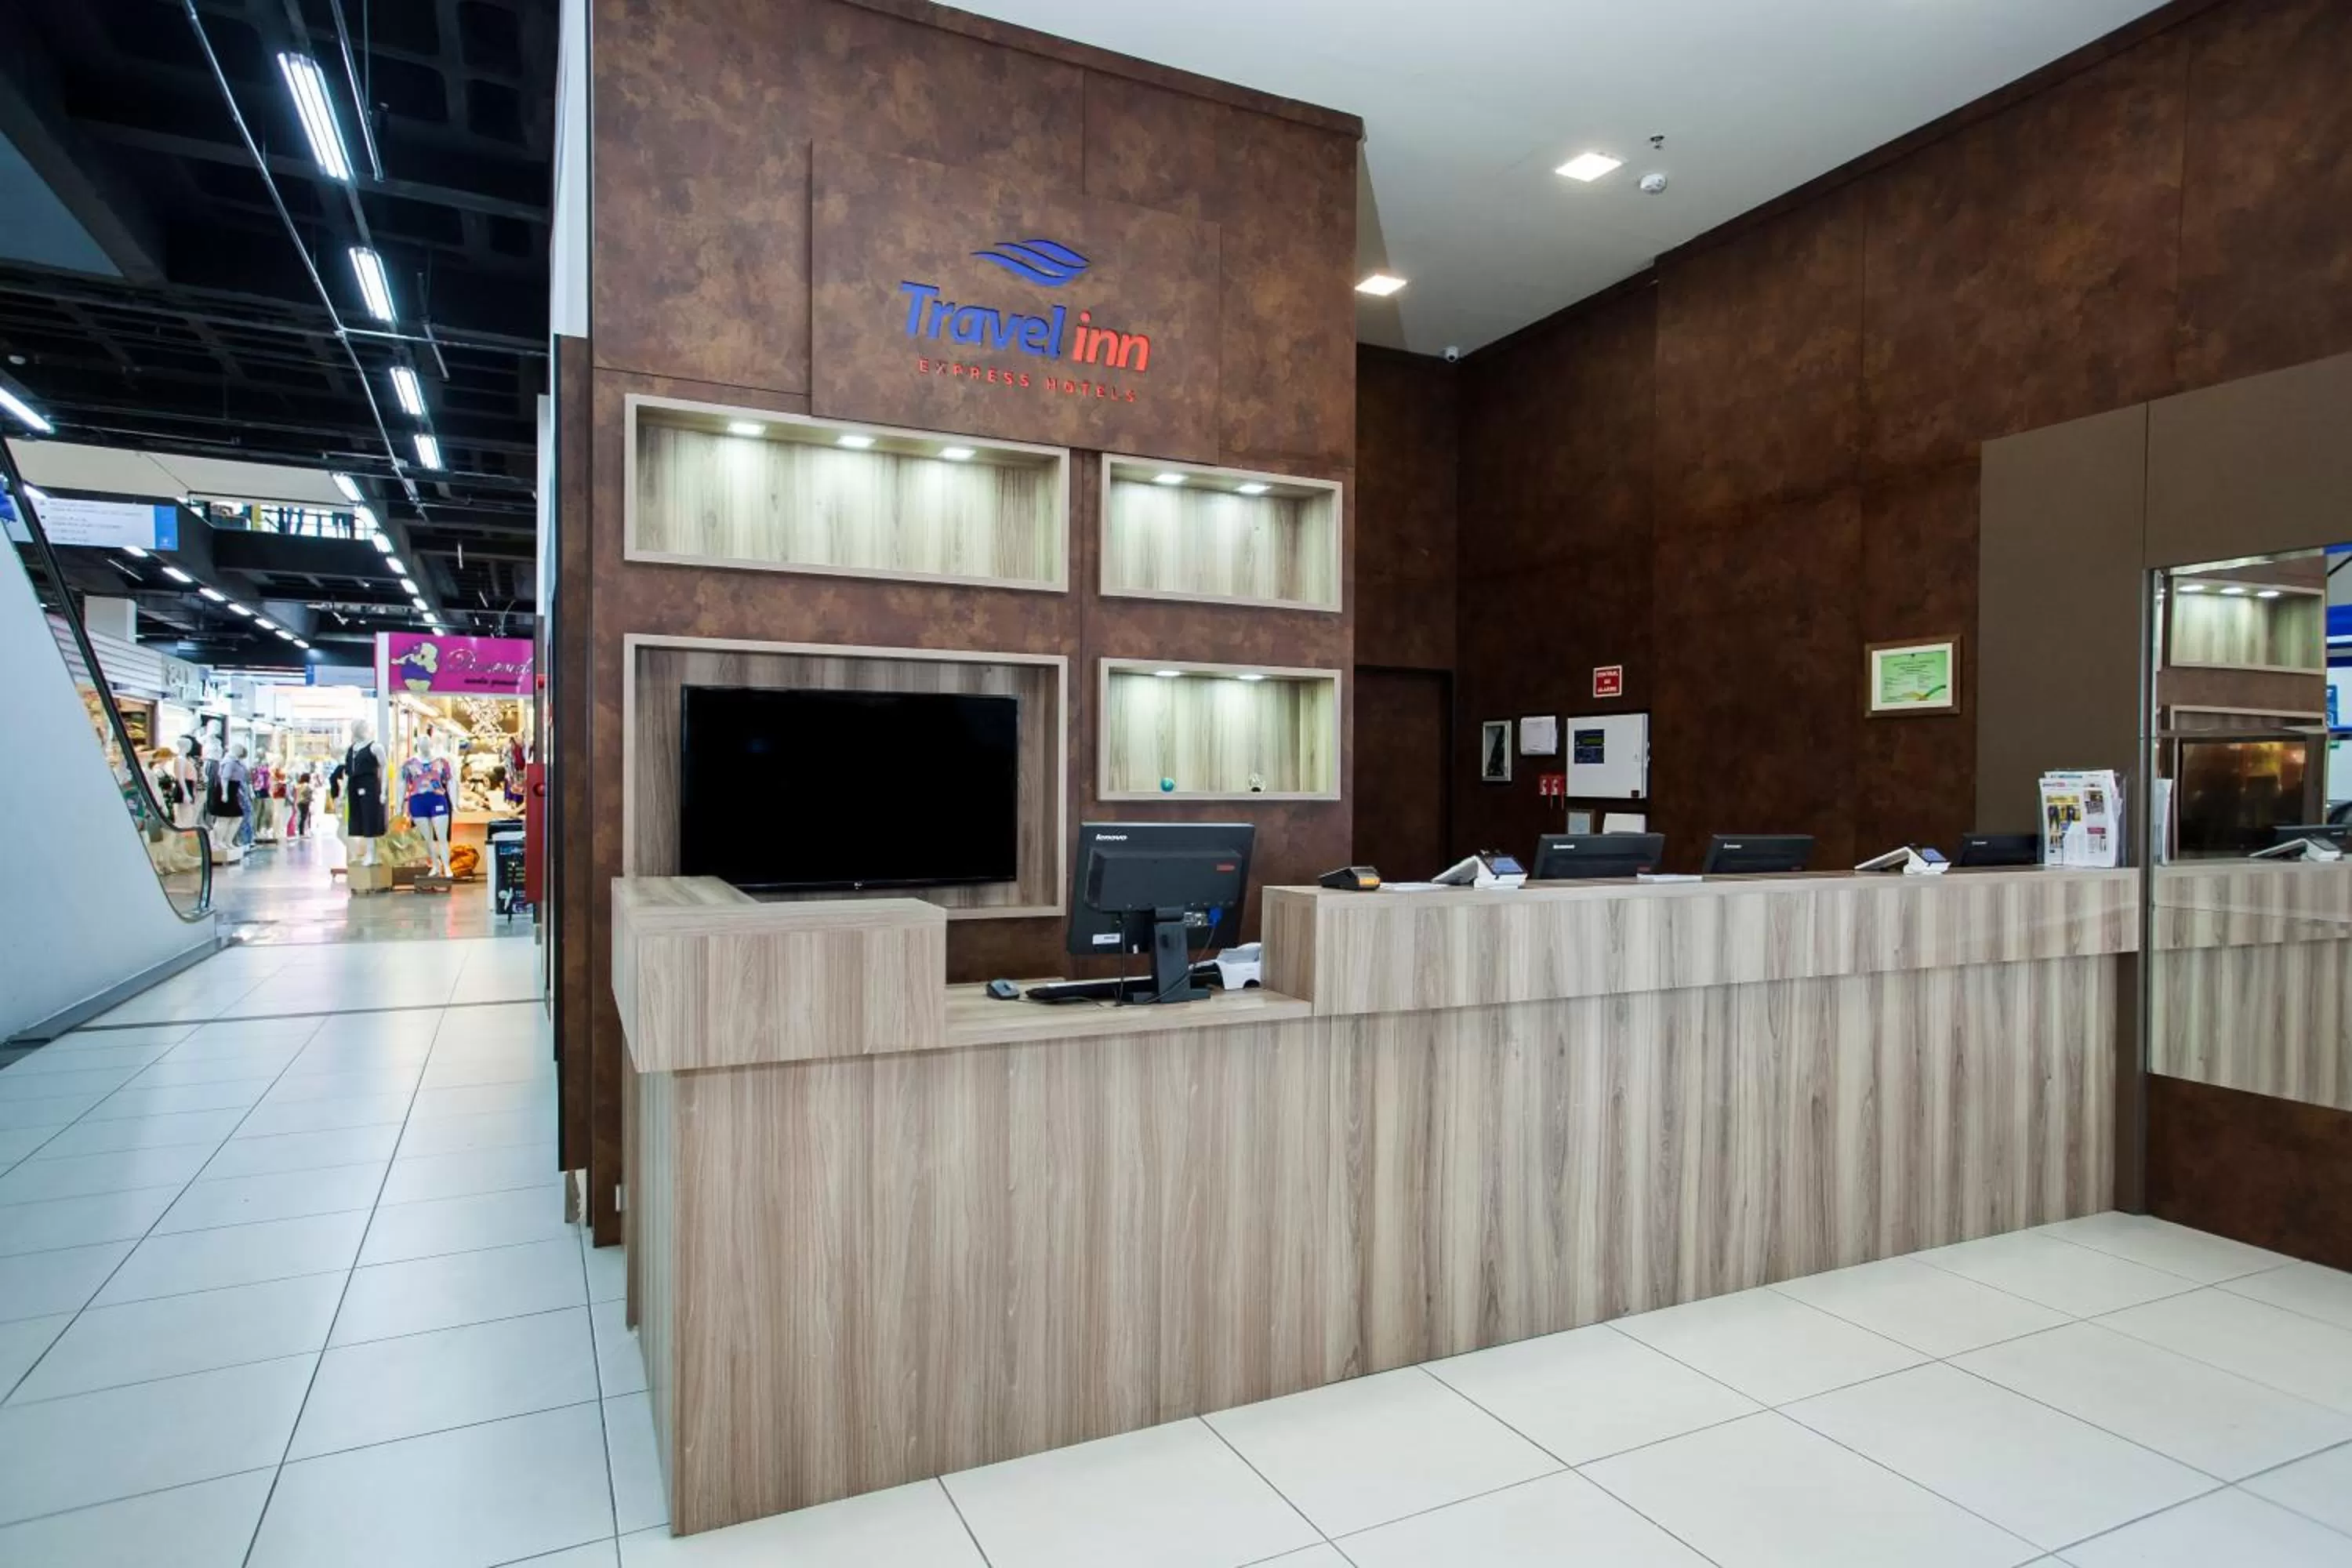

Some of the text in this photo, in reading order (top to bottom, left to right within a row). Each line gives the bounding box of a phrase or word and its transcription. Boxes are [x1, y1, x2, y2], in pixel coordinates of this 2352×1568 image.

[898, 280, 1150, 374] Travel inn
[918, 358, 1136, 402] EXPRESS HOTELS
